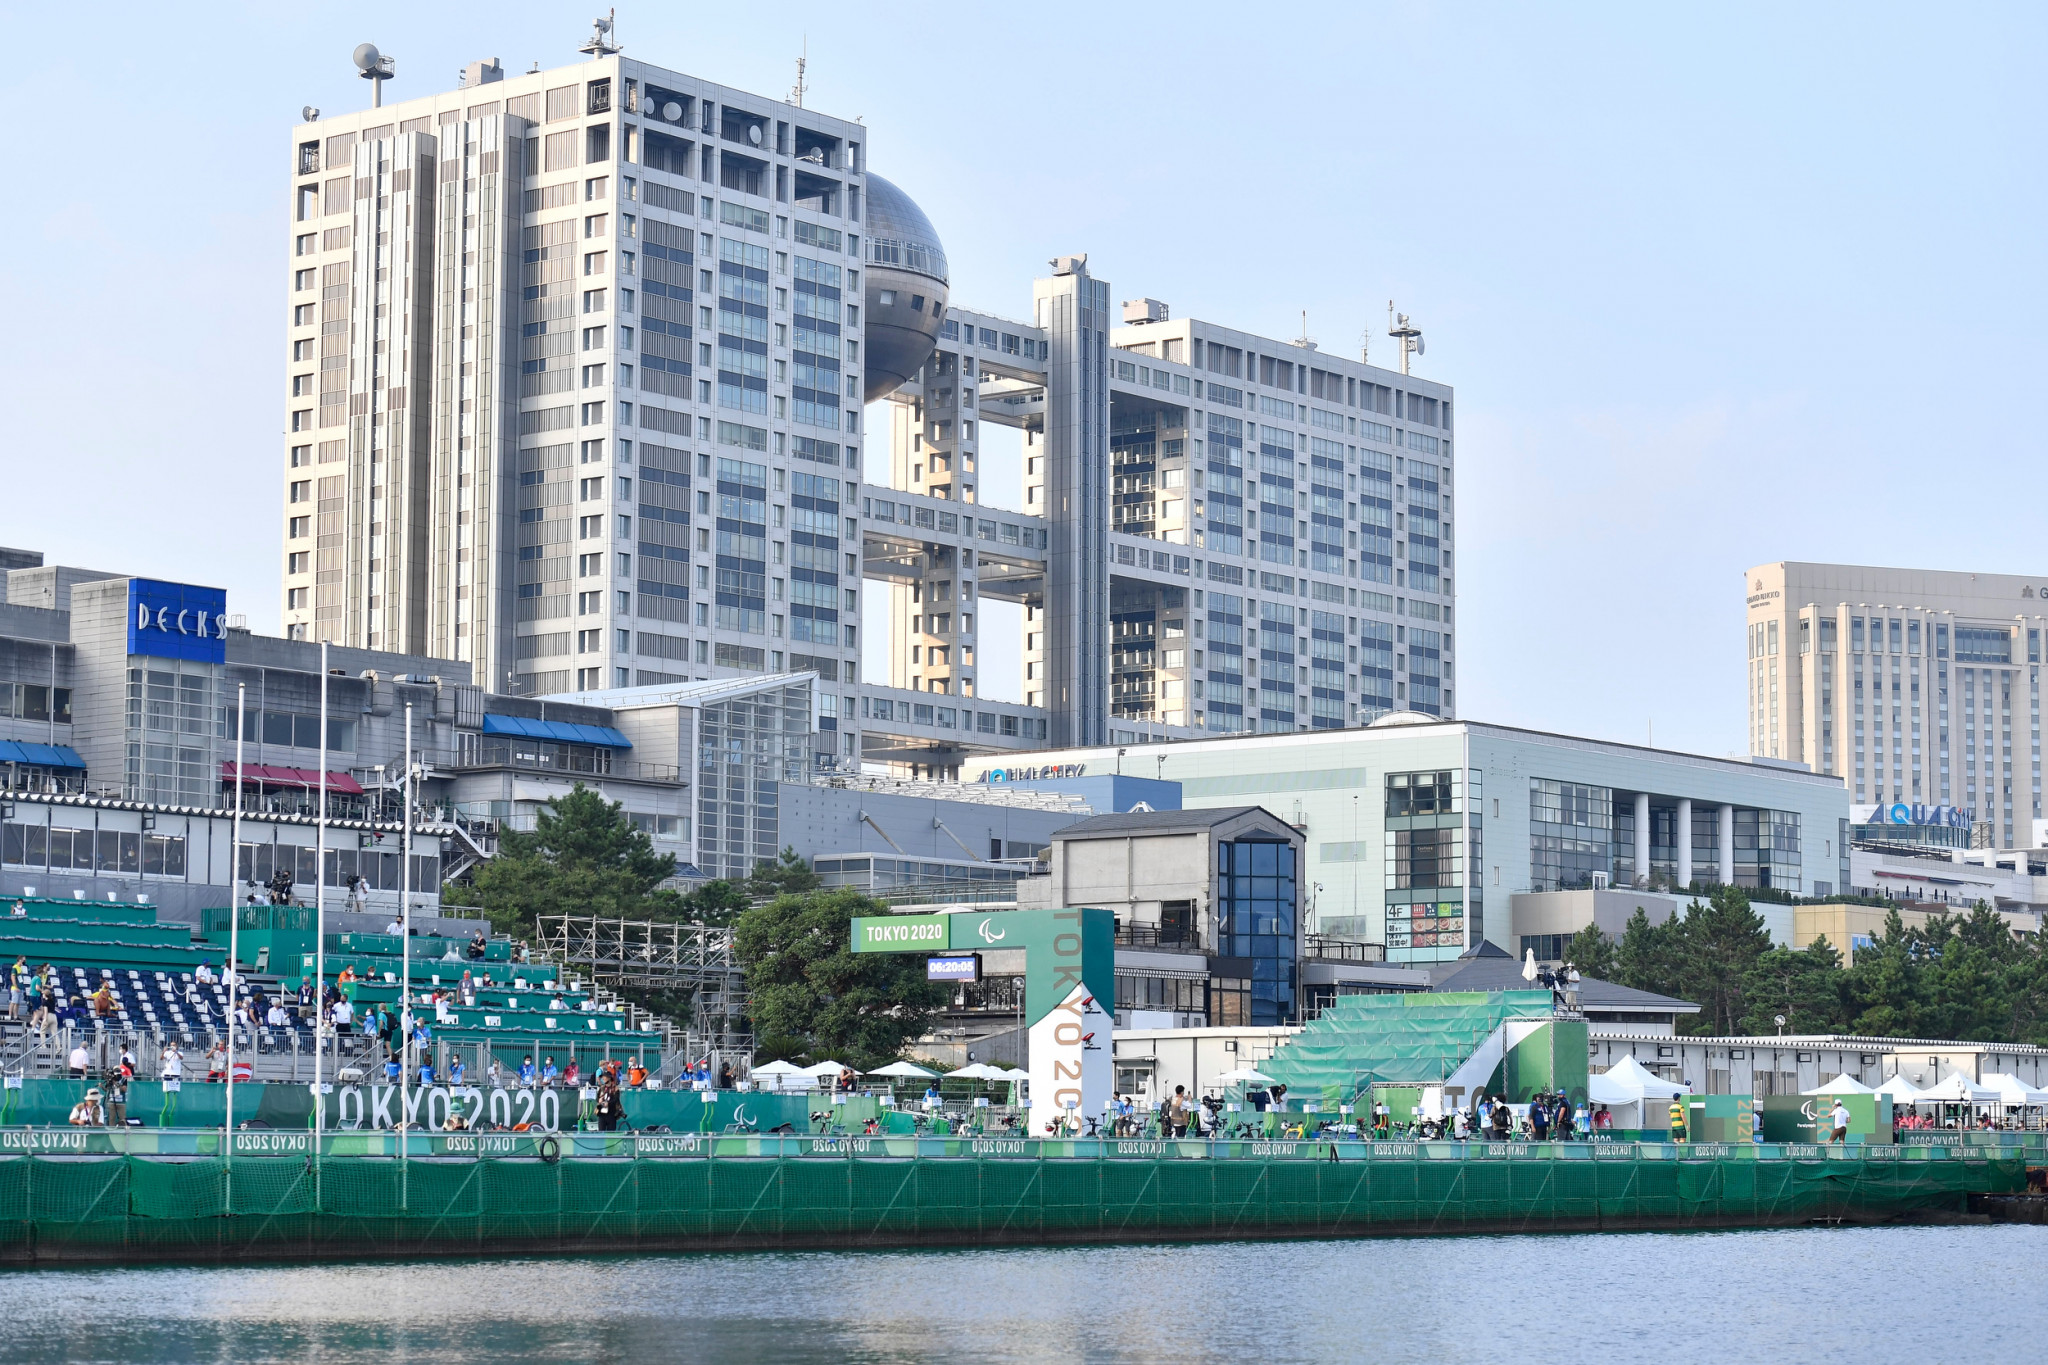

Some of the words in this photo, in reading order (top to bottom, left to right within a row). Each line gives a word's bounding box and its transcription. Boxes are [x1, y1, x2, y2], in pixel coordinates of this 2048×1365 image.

[138, 602, 228, 640] DECKS
[1867, 802, 1943, 825] AQUA
[1388, 904, 1403, 917] 4F
[867, 925, 909, 942] TOKYO
[911, 924, 943, 940] 2020
[929, 961, 974, 973] 06:20:05
[1053, 908, 1083, 1046] TOKYO
[316, 1084, 452, 1132] OKYO
[463, 1087, 560, 1132] 2020
